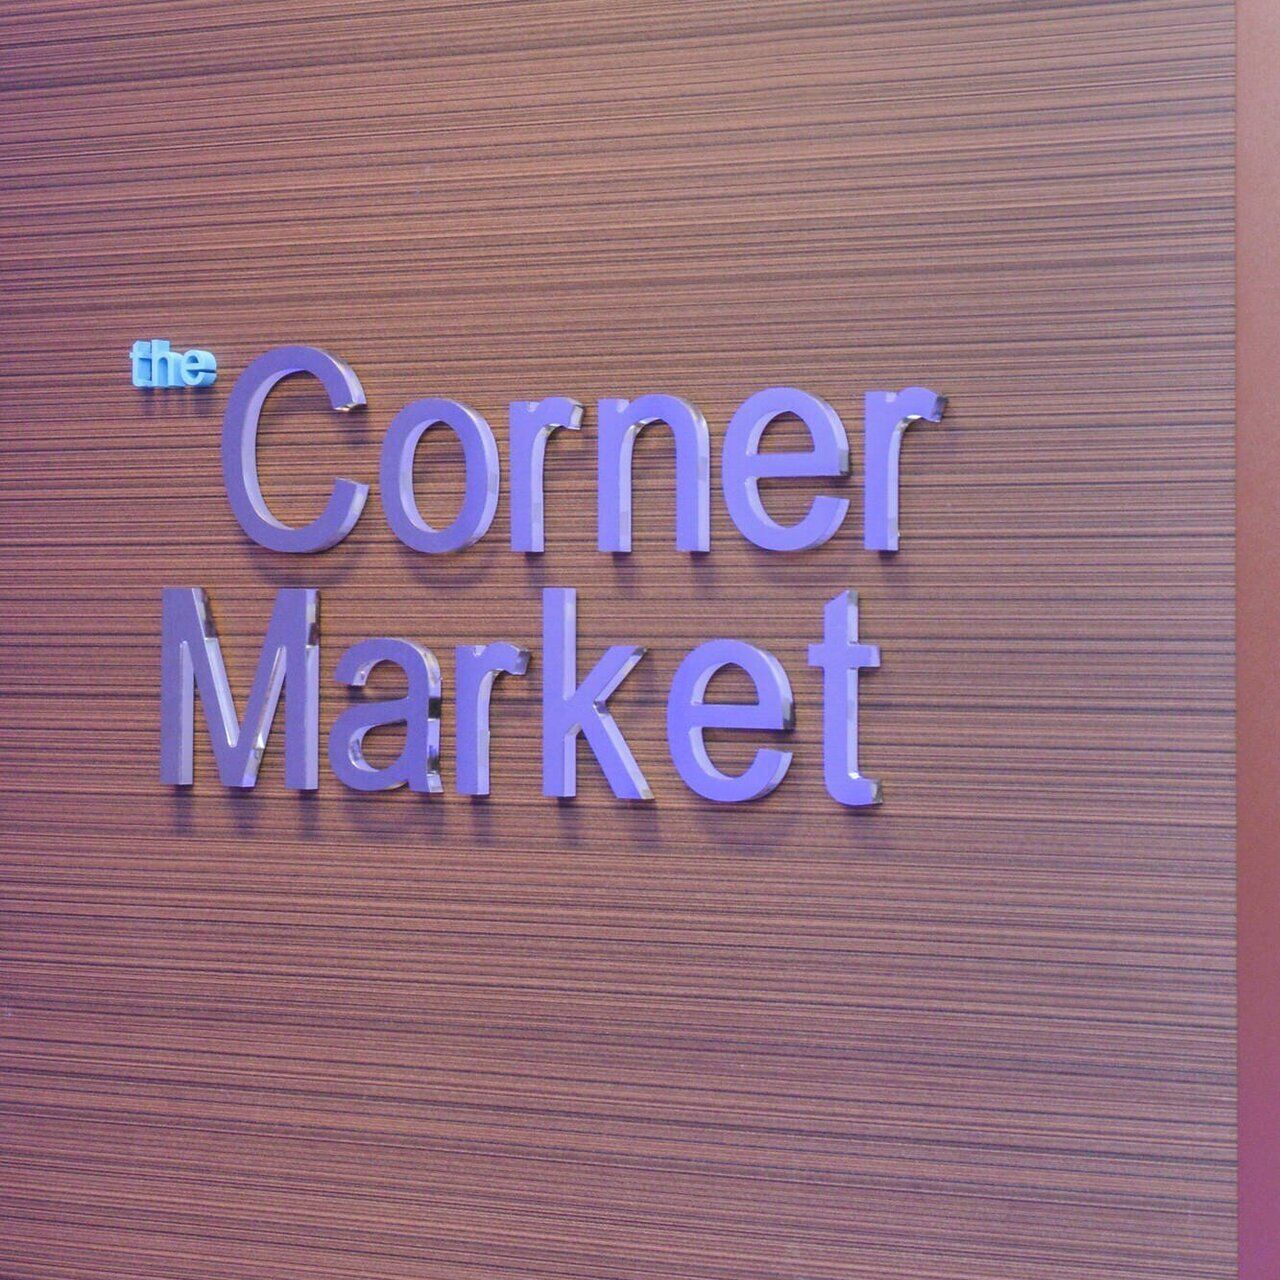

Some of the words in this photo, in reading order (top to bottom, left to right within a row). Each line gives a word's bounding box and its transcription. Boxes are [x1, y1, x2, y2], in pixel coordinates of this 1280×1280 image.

[130, 340, 217, 389] the
[222, 346, 949, 553] Corner
[161, 587, 883, 805] Market
